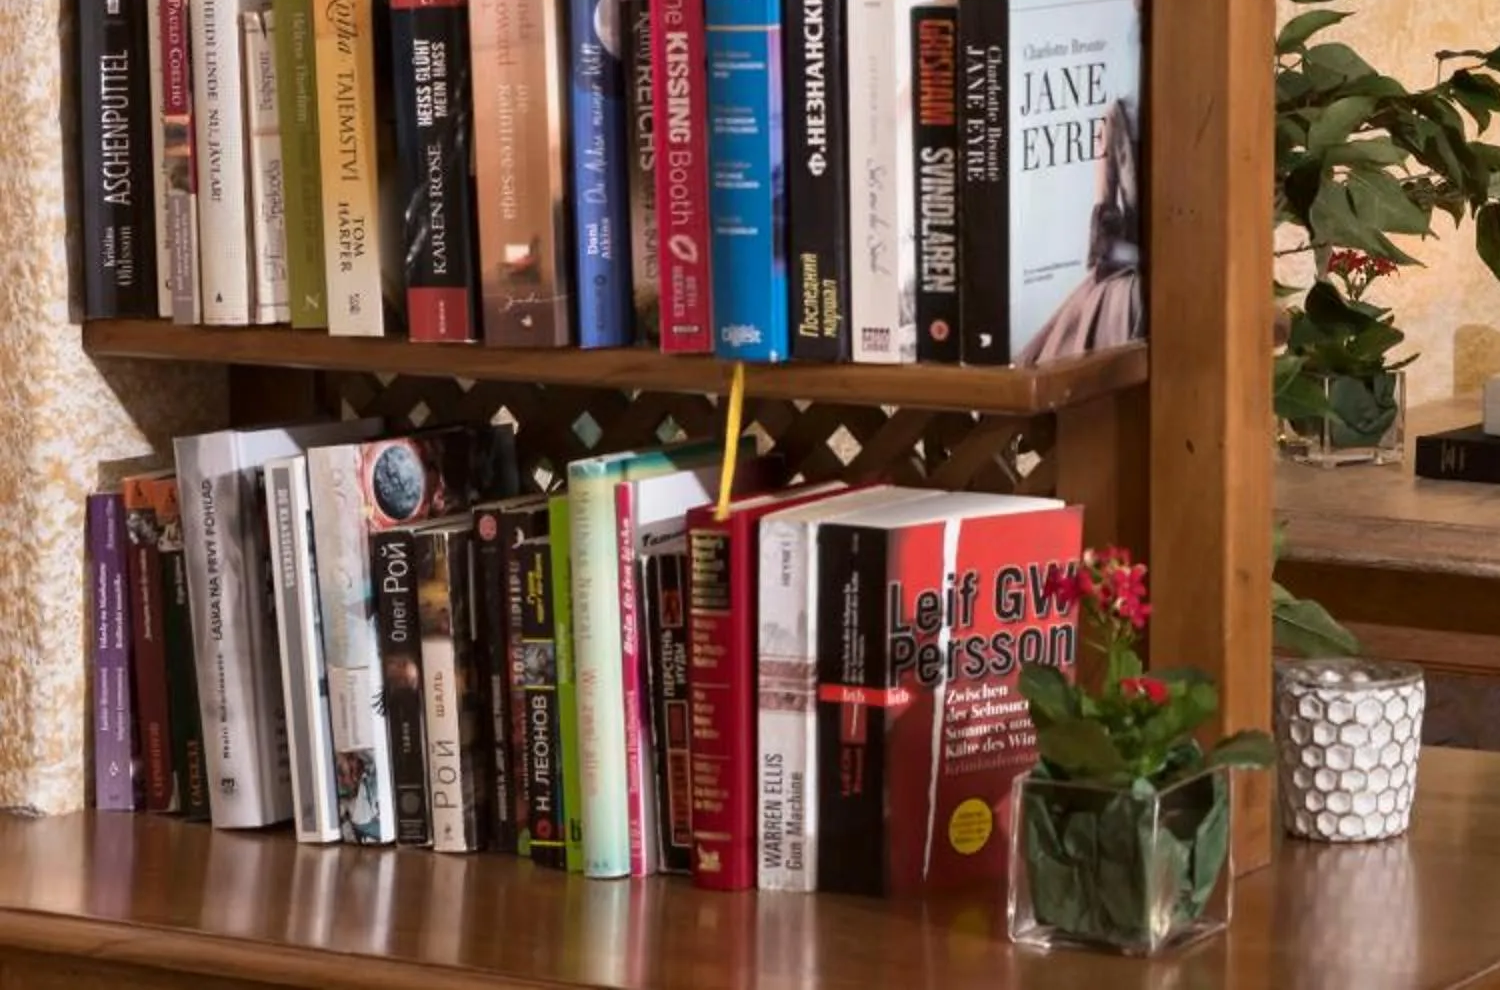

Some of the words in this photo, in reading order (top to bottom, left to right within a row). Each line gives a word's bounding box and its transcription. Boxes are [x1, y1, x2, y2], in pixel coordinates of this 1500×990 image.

[203, 0, 215, 46] HEIDI
[169, 47, 184, 107] COELHO
[206, 51, 218, 100] LINDE
[415, 39, 431, 83] GLÜHT
[432, 42, 446, 75] HASS
[918, 19, 955, 125] GRISHAM
[966, 46, 985, 109] JANE
[1023, 40, 1068, 61] Charlotte
[417, 86, 433, 128] HEISS
[434, 79, 447, 118] MEIN
[665, 31, 691, 143] KISSING
[986, 45, 1001, 122] Charlotte
[1020, 62, 1107, 116] JANE
[100, 50, 130, 206] ASCHENPUTTEL
[637, 66, 656, 170] REICHS
[1022, 118, 1108, 172] EYRE
[429, 145, 444, 197] ROSE
[967, 116, 986, 183] EYRE
[669, 150, 692, 225] Booth
[339, 202, 353, 273] HARPER
[352, 217, 365, 256] TOM
[431, 207, 447, 274] KAREN
[587, 223, 598, 257] Dani
[921, 147, 956, 294] SVINDLAREN
[800, 253, 819, 339] Последний
[822, 278, 841, 339] маршал
[390, 597, 407, 642] Олег
[888, 570, 978, 636] Leif
[661, 630, 675, 696] ПЕРСТЕНЬ
[675, 643, 687, 684] ИУДЫ
[888, 622, 1078, 691] Persson
[947, 683, 1008, 705] Zwischen
[947, 707, 967, 723] der
[534, 695, 549, 785] ЛЕОНОВ
[946, 721, 1007, 740] Sommers
[983, 737, 1005, 753] des
[536, 792, 550, 812] Н.
[765, 754, 784, 807] ELLIS
[786, 772, 803, 837] Machine
[764, 815, 783, 870] WARREN
[786, 840, 802, 872] Gun
